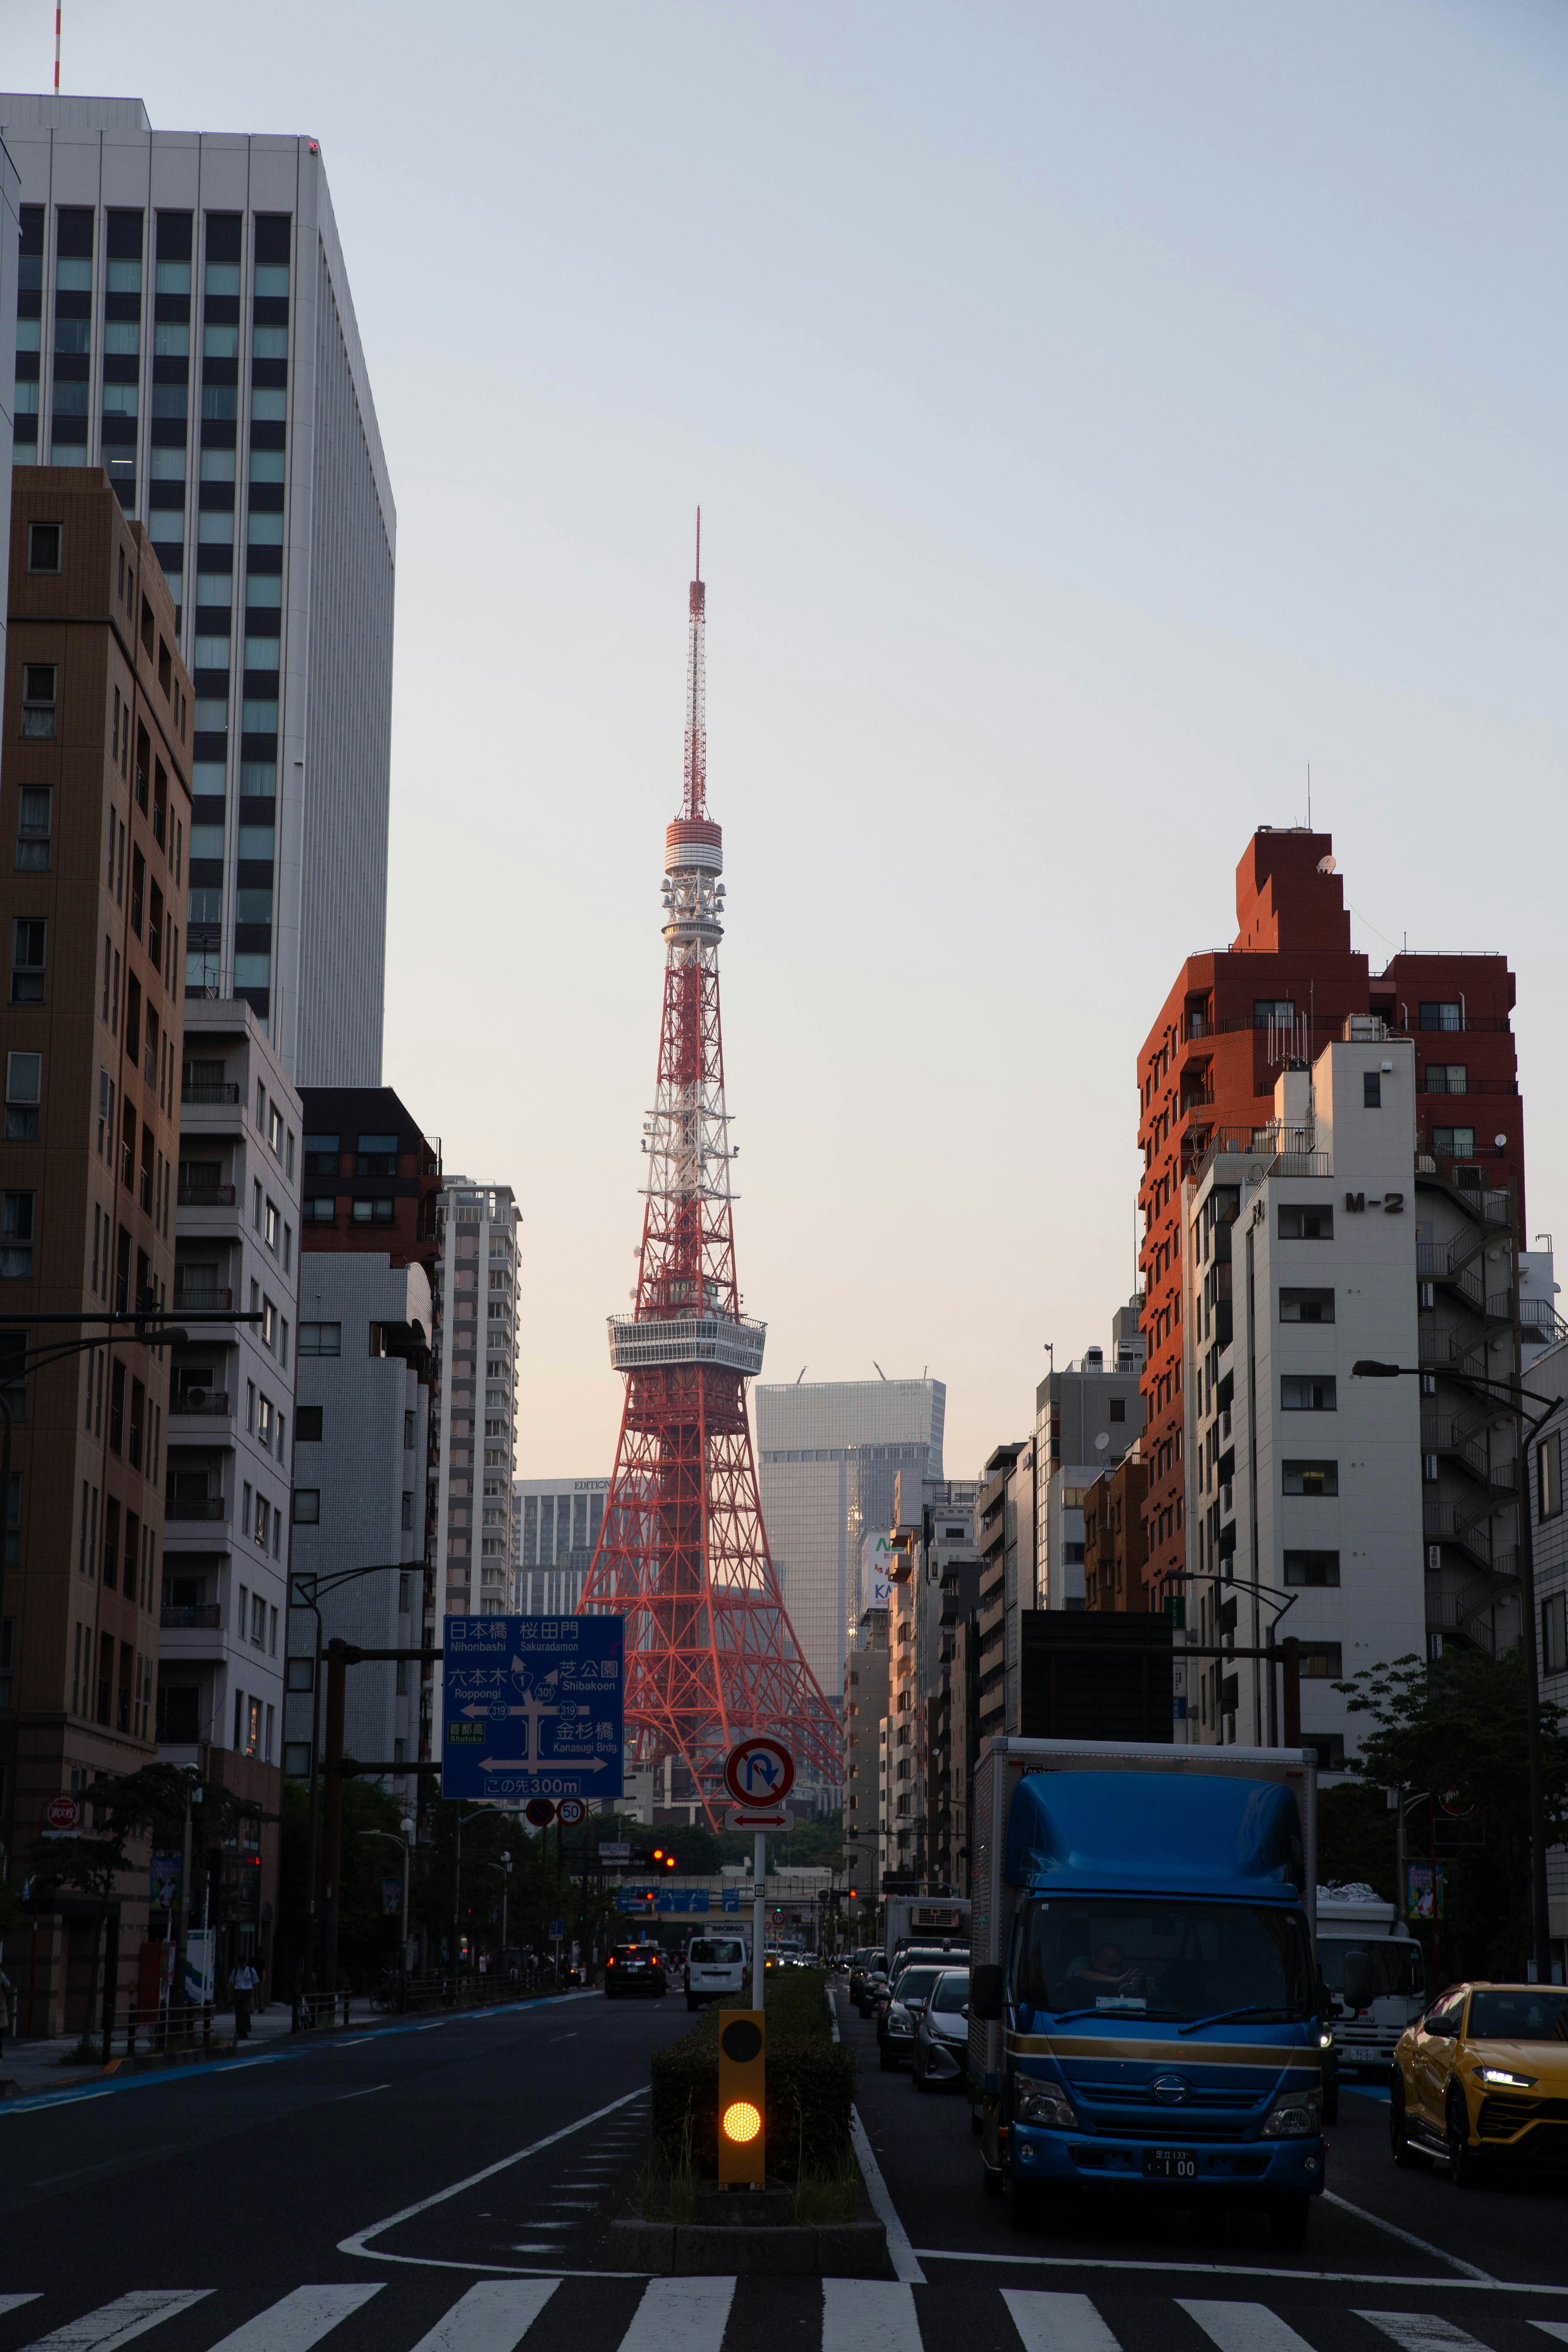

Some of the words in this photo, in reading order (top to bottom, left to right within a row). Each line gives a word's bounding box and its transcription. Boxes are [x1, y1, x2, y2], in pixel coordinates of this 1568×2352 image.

[1346, 1192, 1404, 1212] M-2
[574, 1480, 611, 1490] EDITION
[450, 1621, 508, 1639] 日本橋
[520, 1621, 579, 1639] 桜田門
[450, 1642, 506, 1651] Nihonbashi
[521, 1642, 578, 1651] Sakuradamon
[559, 1660, 618, 1678] 芝公園
[448, 1668, 508, 1687] 六本木
[519, 1675, 524, 1687] 1
[538, 1687, 552, 1697] 301
[563, 1681, 615, 1691] Shibakoen
[455, 1688, 501, 1700] Roppongi
[491, 1706, 505, 1715] 319
[561, 1706, 575, 1715] 319
[450, 1723, 484, 1735] 首都高
[556, 1721, 613, 1740] 金杉橋
[553, 1742, 594, 1754] Kanasugi
[596, 1742, 619, 1753] Brdg.
[51, 1807, 74, 1819] 消火栓
[564, 1805, 579, 1818] 50
